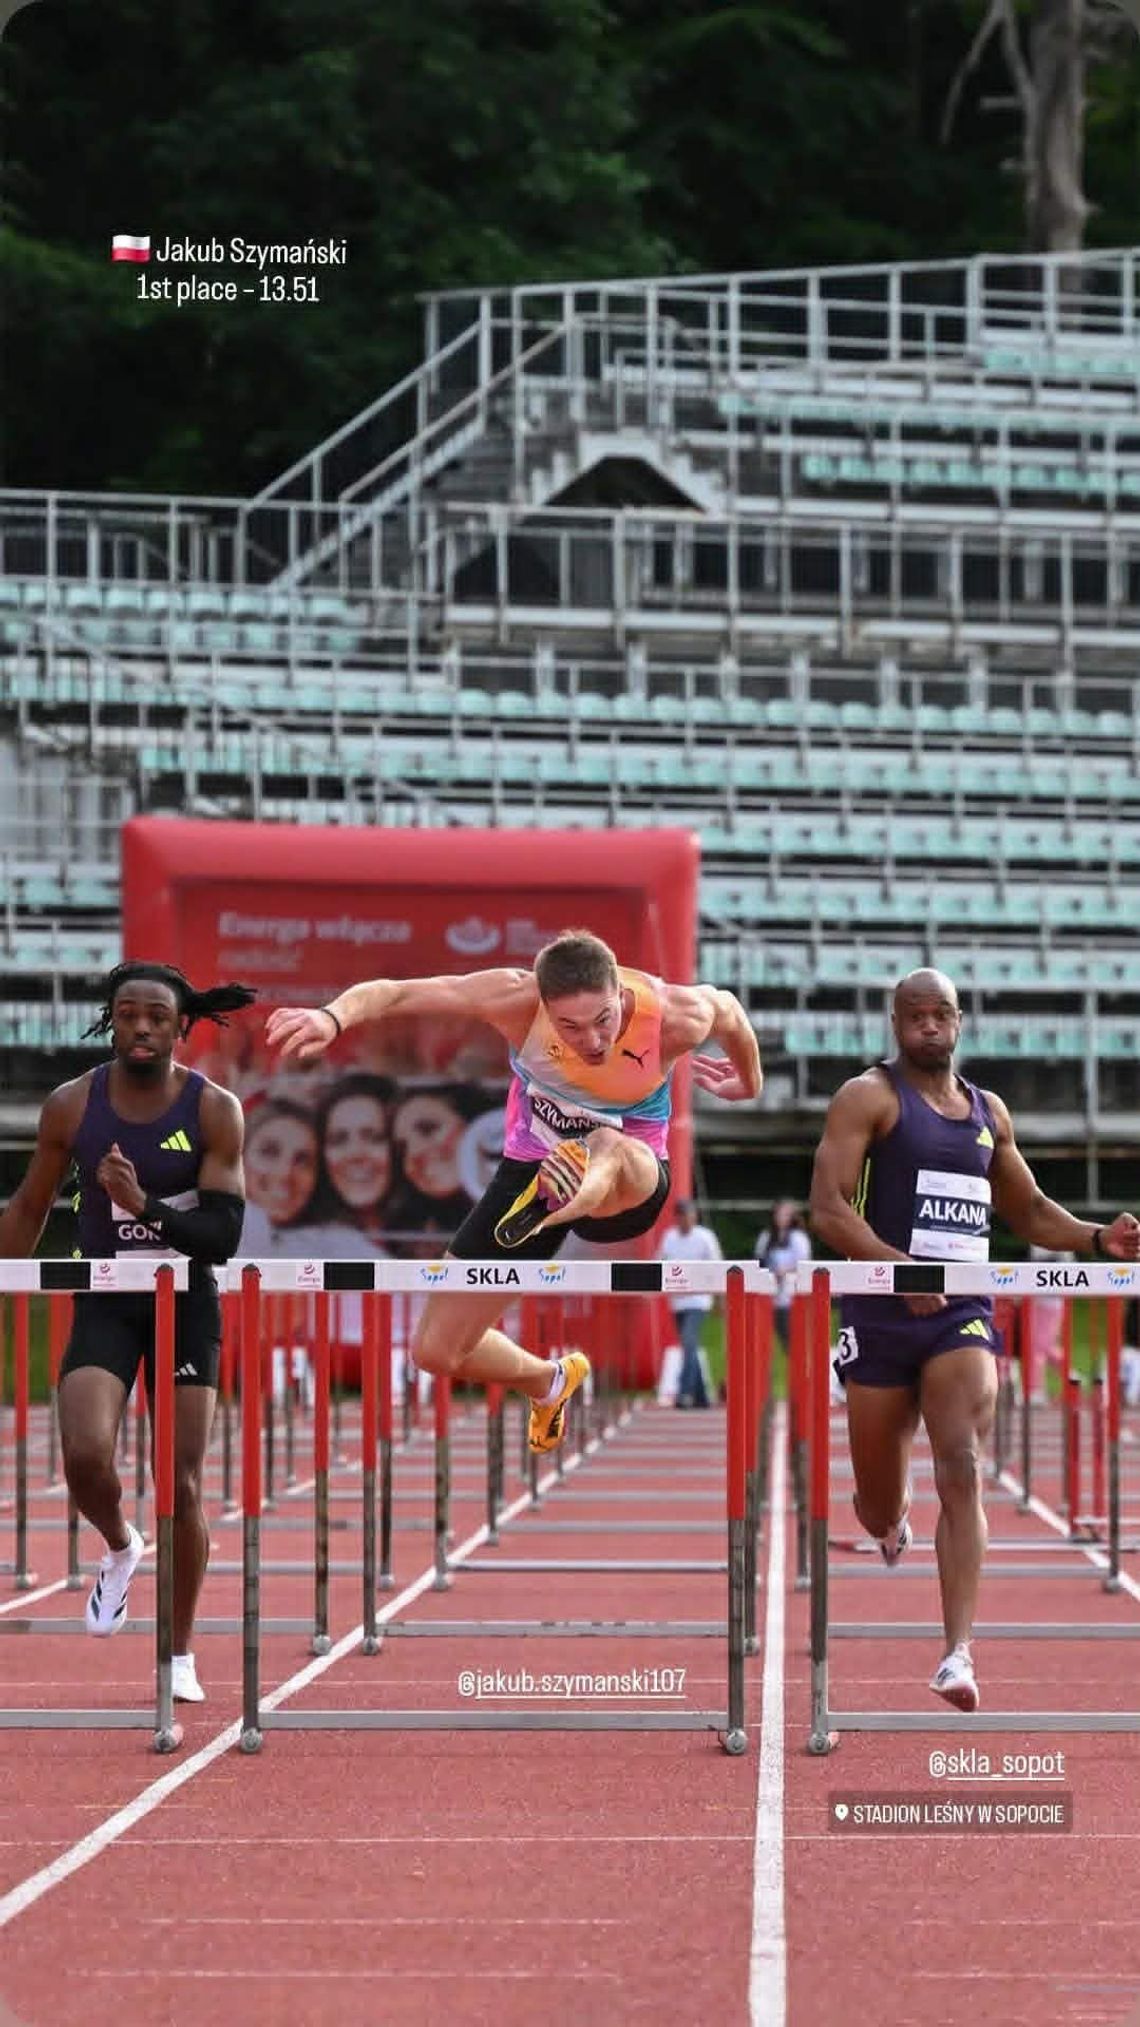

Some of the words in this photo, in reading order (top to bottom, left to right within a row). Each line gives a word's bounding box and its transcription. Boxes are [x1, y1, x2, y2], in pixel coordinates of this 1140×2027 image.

[919, 1199, 987, 1226] ALKANA
[466, 1267, 520, 1285] SKLA
[1036, 1270, 1090, 1287] SKLA
